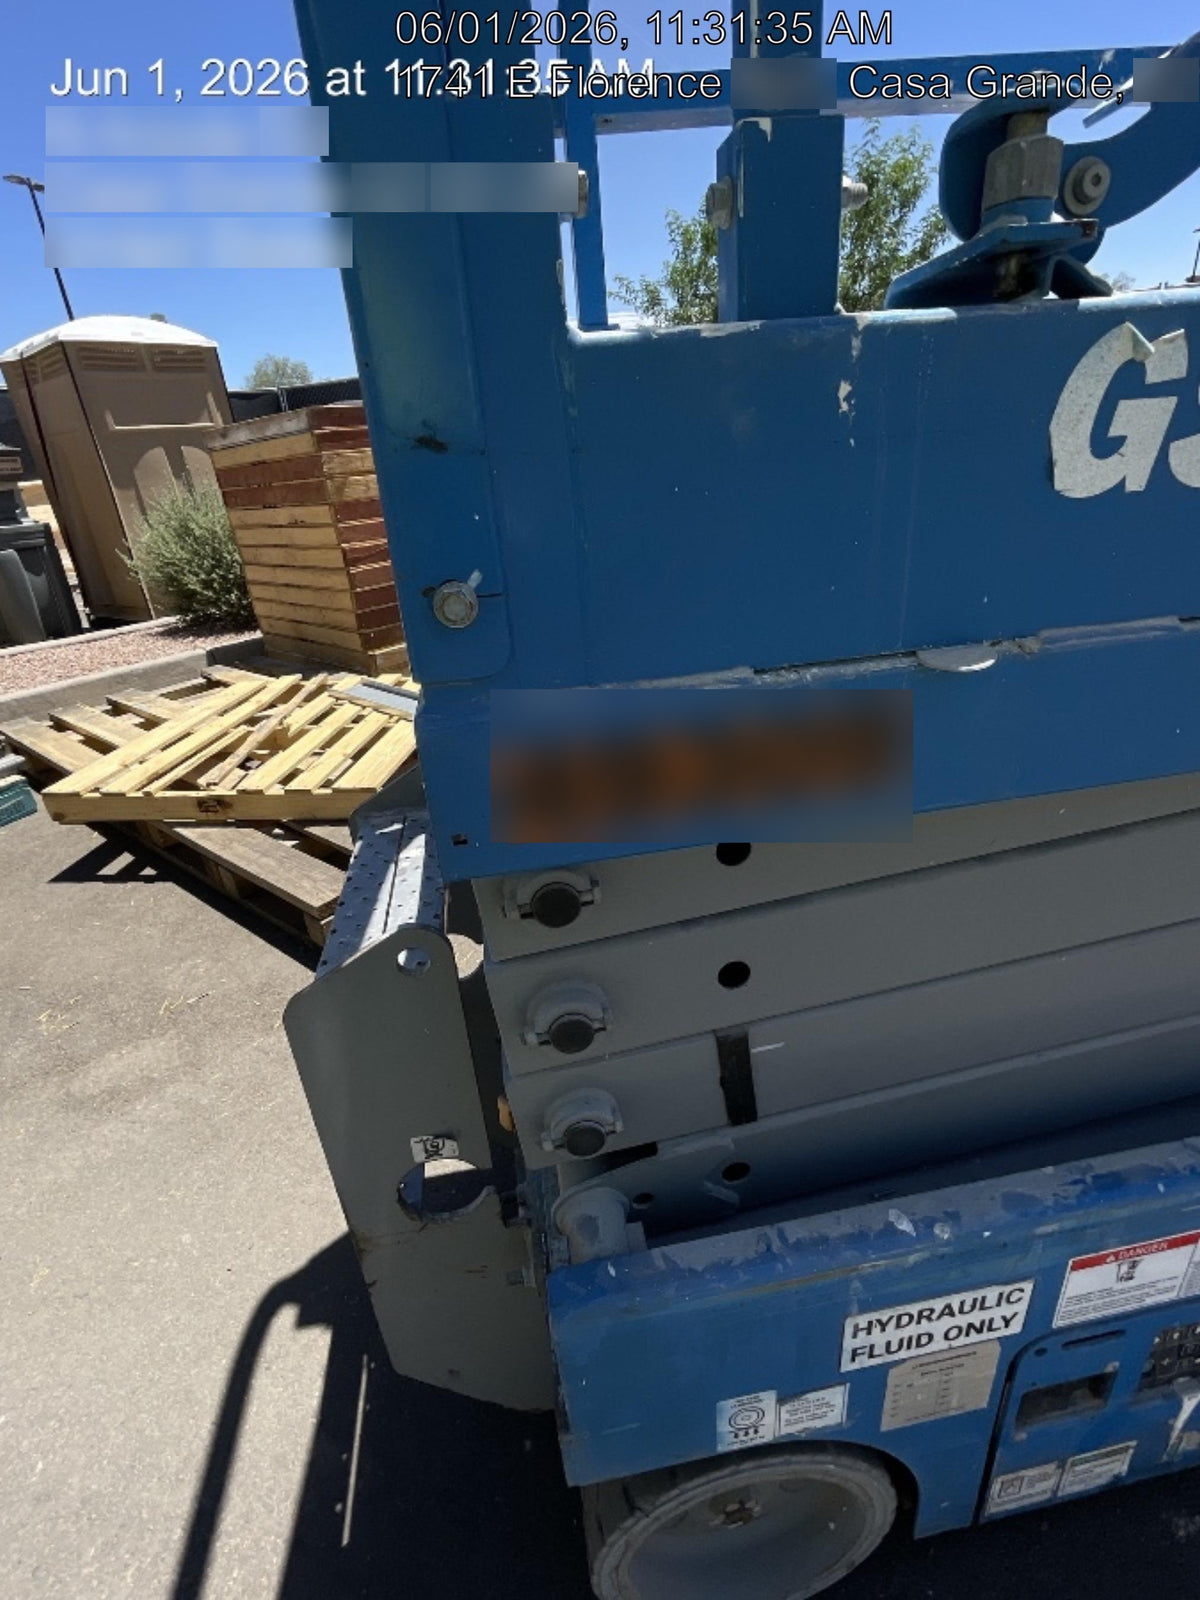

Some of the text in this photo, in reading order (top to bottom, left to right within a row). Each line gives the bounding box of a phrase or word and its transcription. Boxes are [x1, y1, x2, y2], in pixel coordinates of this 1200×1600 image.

[850, 1332, 934, 1363] FLUID
[943, 1312, 1019, 1342] ONLY
[852, 1287, 1025, 1339] HYDRAULIC
